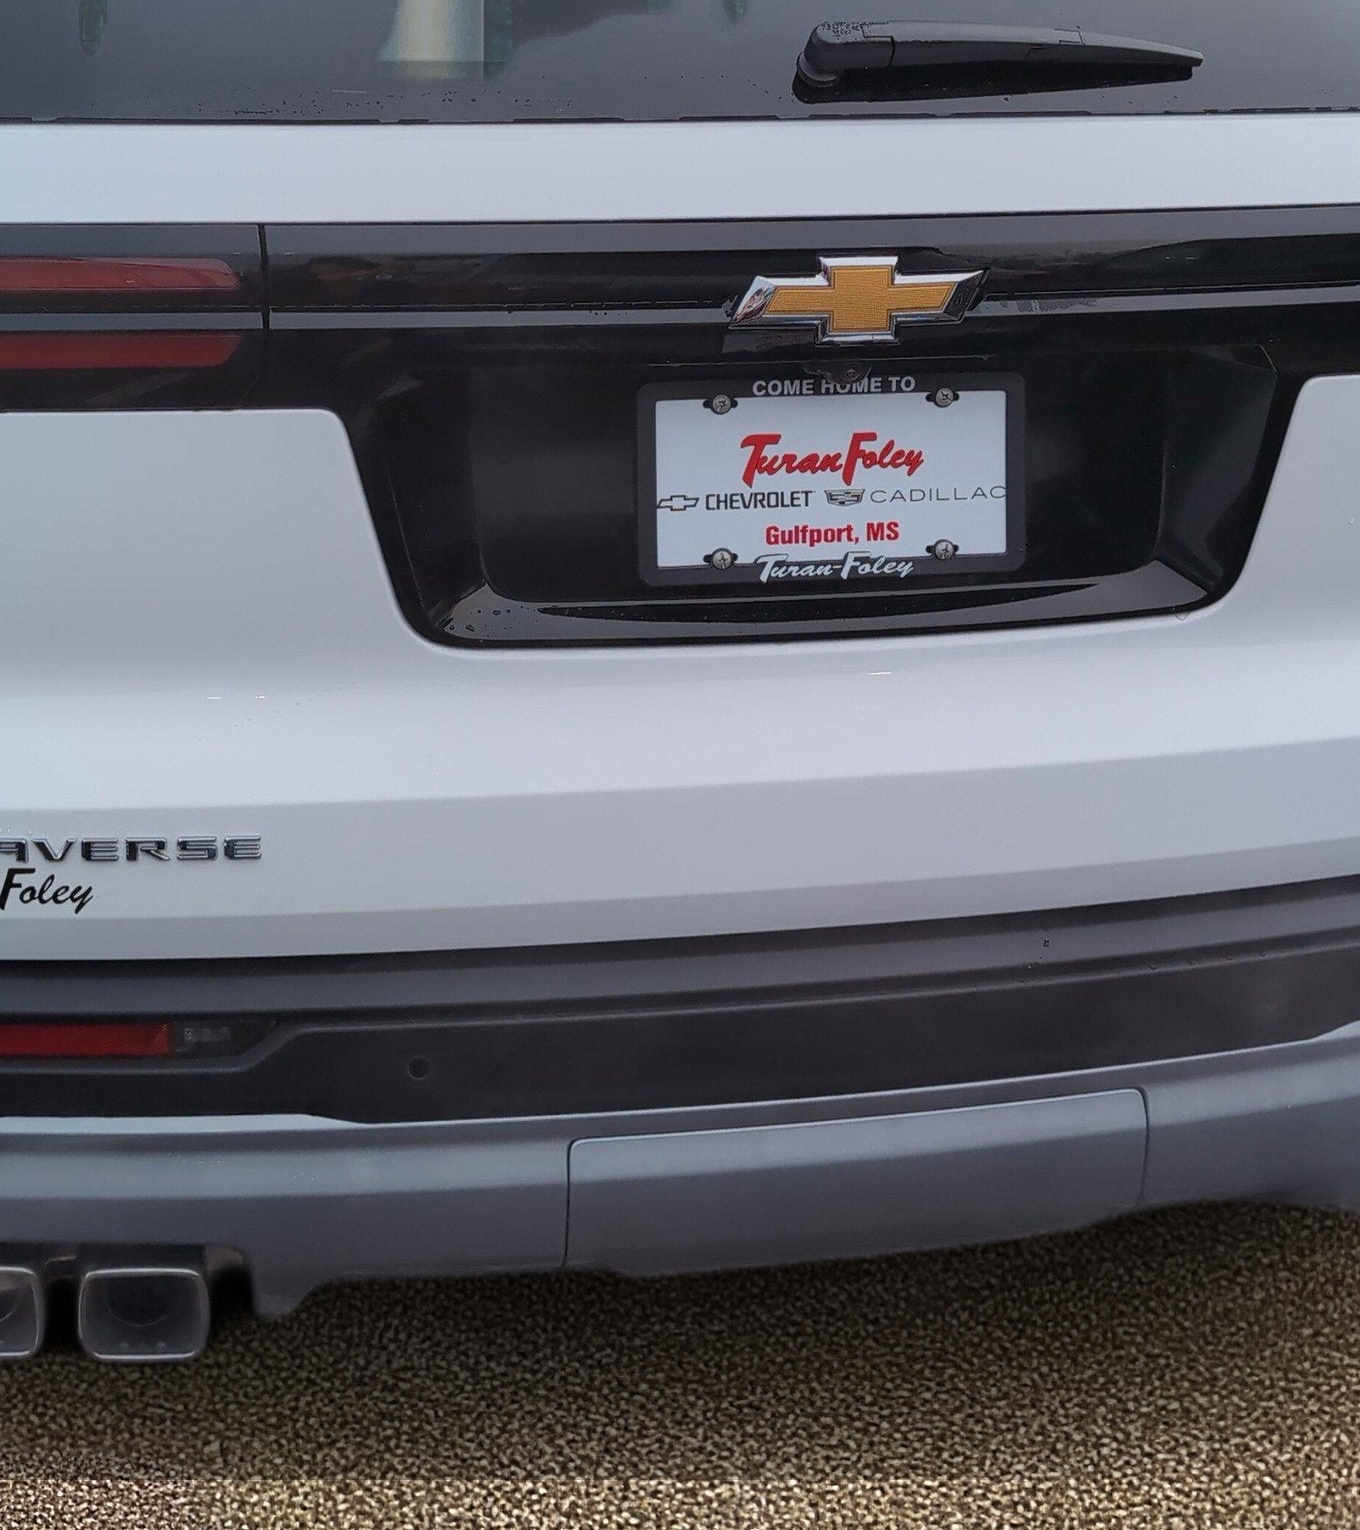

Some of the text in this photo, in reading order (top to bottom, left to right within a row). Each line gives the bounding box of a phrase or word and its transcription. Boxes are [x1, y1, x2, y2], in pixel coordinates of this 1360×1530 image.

[752, 379, 814, 396] COME
[889, 375, 916, 392] TO
[705, 485, 1008, 511] CHEVROLET CADILLAC
[765, 521, 900, 547] Gulfport, MS
